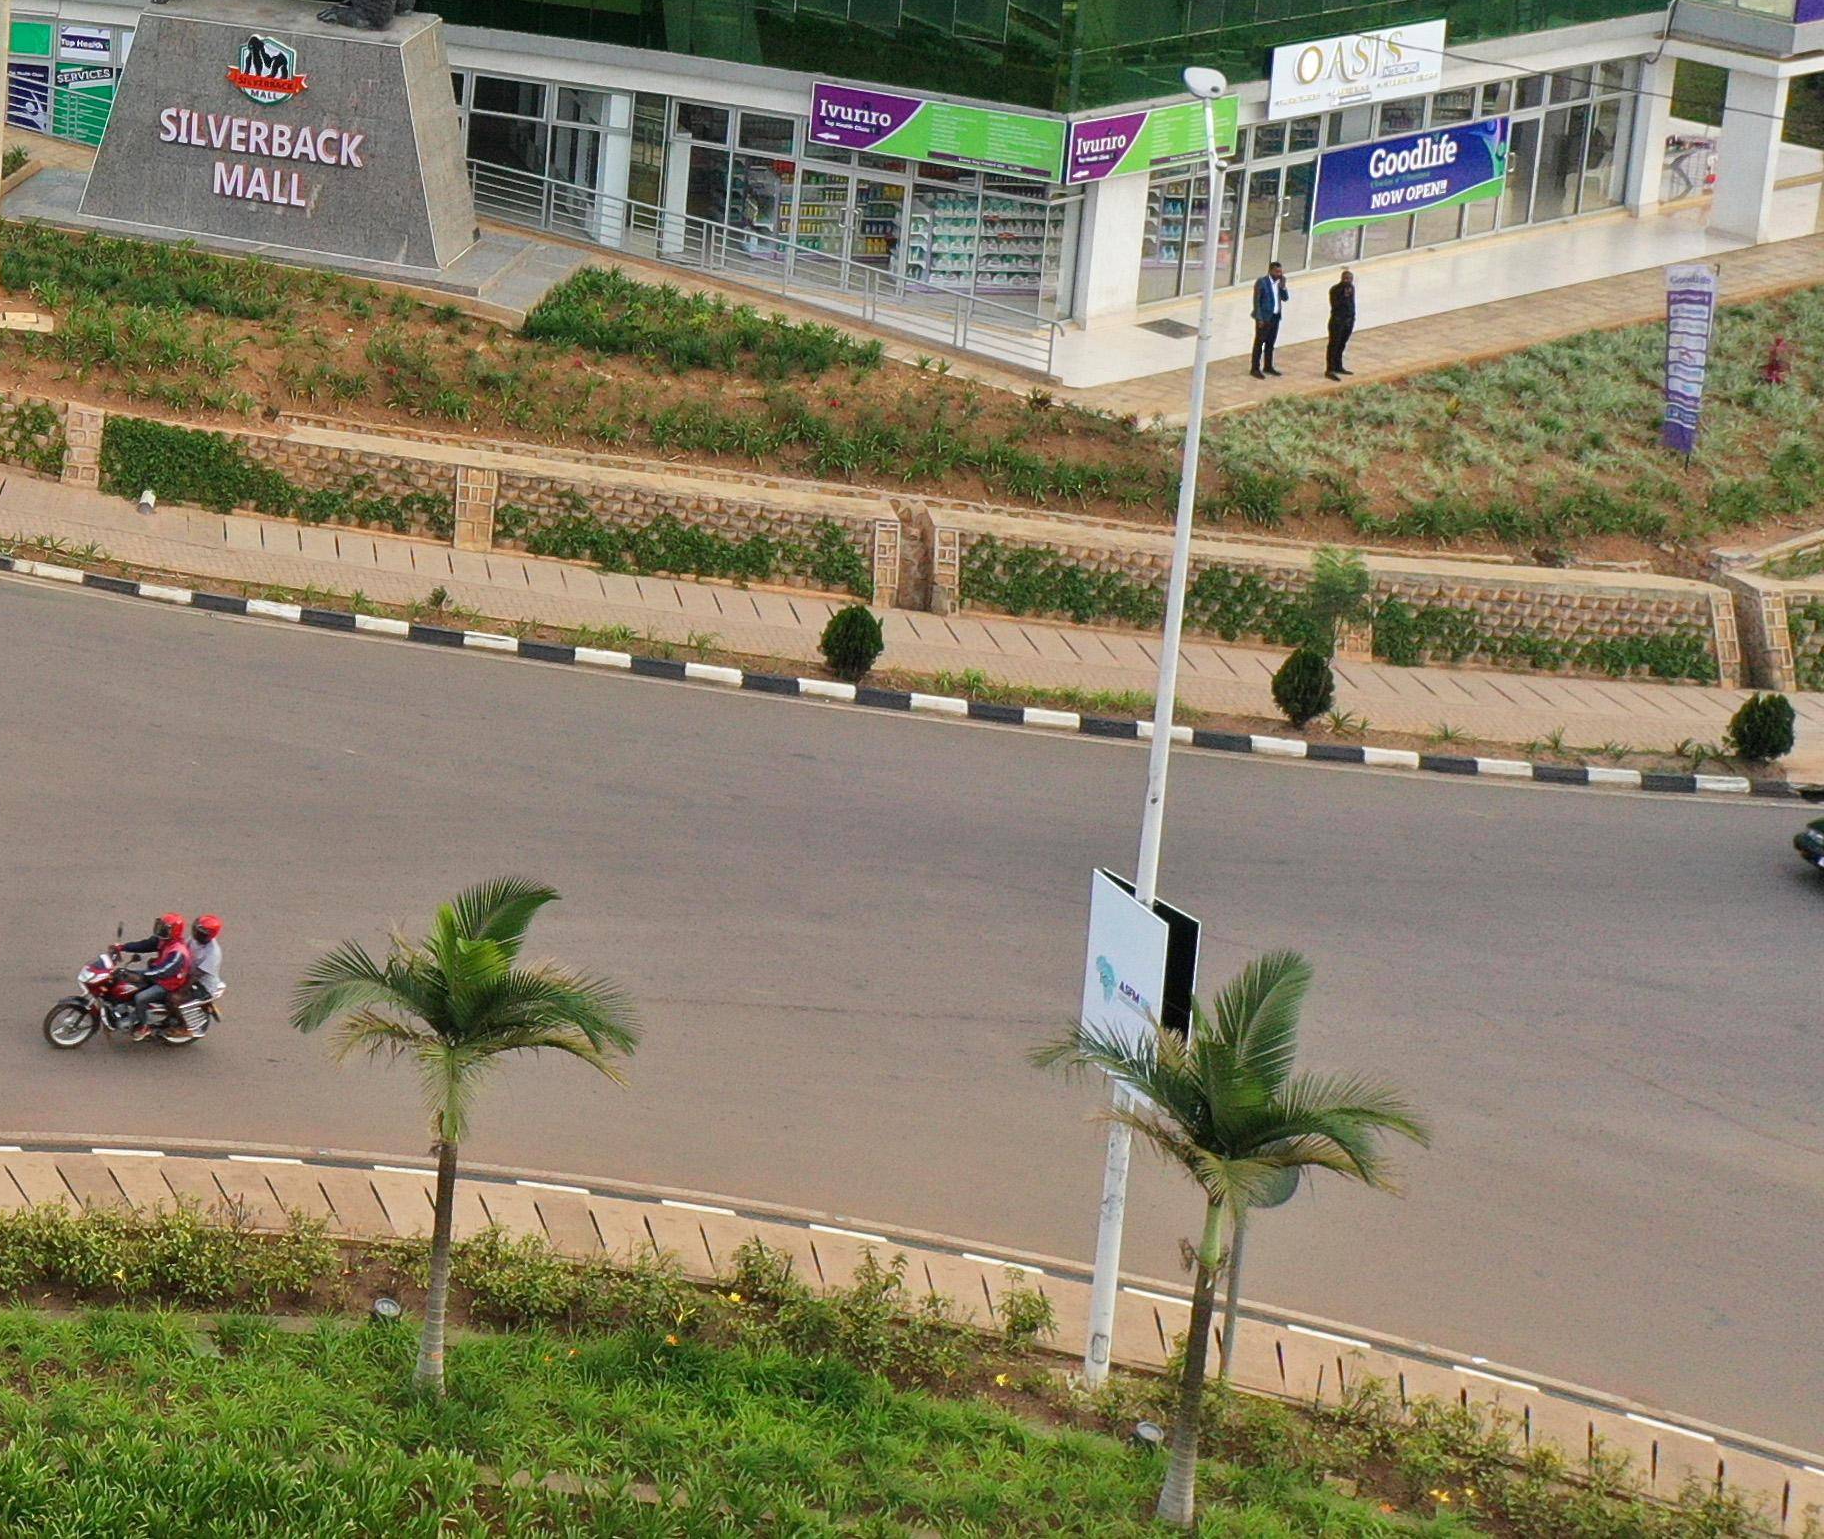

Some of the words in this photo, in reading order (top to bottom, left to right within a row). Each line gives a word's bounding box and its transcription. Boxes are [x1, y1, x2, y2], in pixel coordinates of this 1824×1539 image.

[61, 37, 75, 49] Top
[76, 38, 104, 50] Health
[1294, 30, 1403, 85] OASIS
[57, 67, 111, 84] SERVICES
[237, 77, 295, 90] SILVERBACK
[251, 89, 278, 100] MALL
[819, 99, 892, 127] Ivuriro
[159, 107, 364, 168] SILVERBACK
[1076, 134, 1127, 155] Ivuriro
[1369, 134, 1458, 178] Goodlife
[213, 161, 306, 207] MALL
[1370, 189, 1404, 209] NOW
